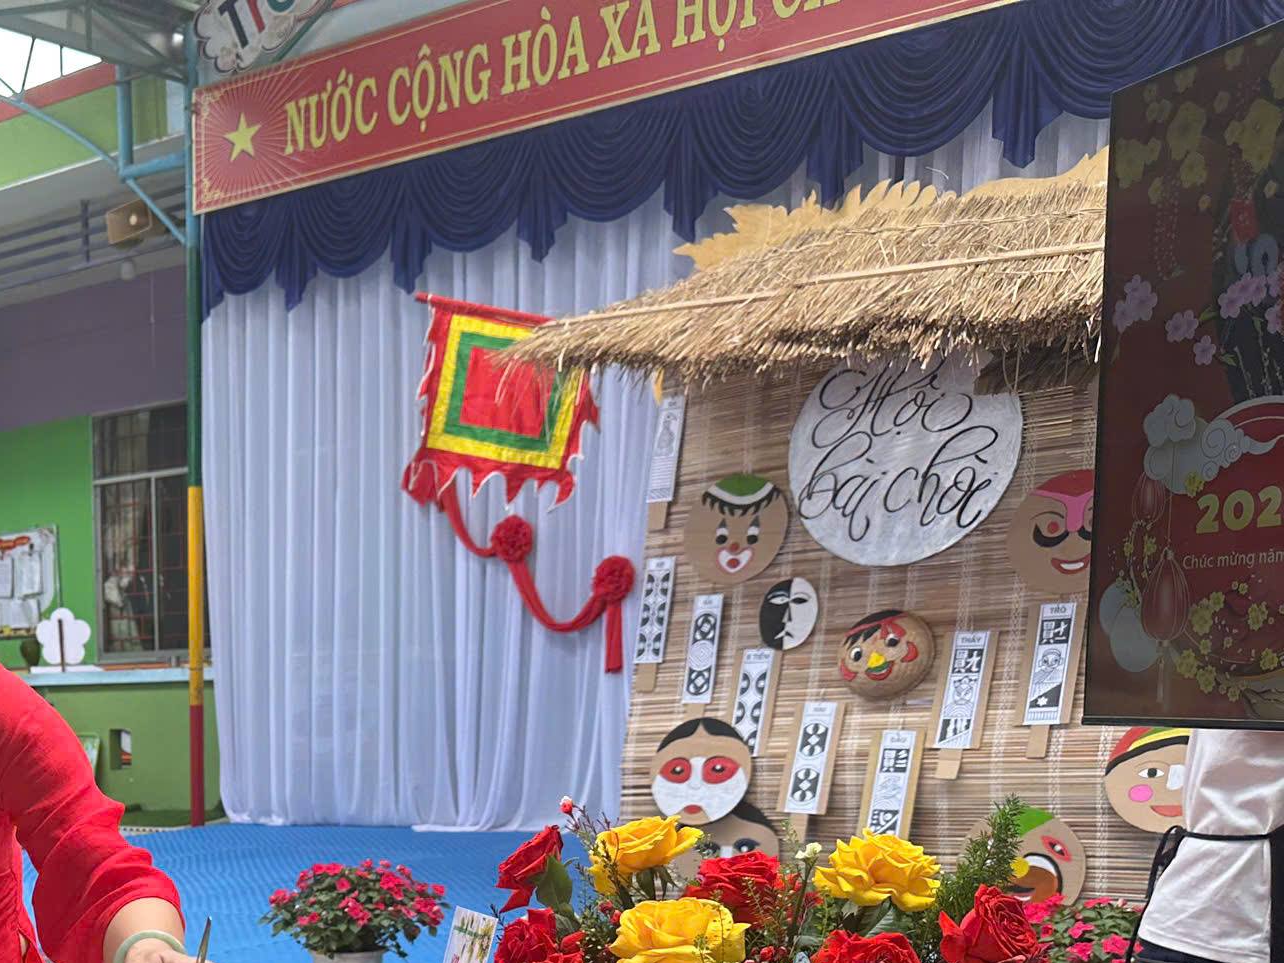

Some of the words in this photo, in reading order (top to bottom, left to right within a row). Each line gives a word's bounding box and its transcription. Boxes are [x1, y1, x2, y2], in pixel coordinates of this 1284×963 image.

[218, 0, 295, 48] TI
[284, 68, 378, 155] NƯỚC
[387, 43, 491, 133] CỘNG
[501, 6, 589, 95] HÒA
[1183, 554, 1213, 570] Chúc
[1217, 551, 1255, 569] mừng
